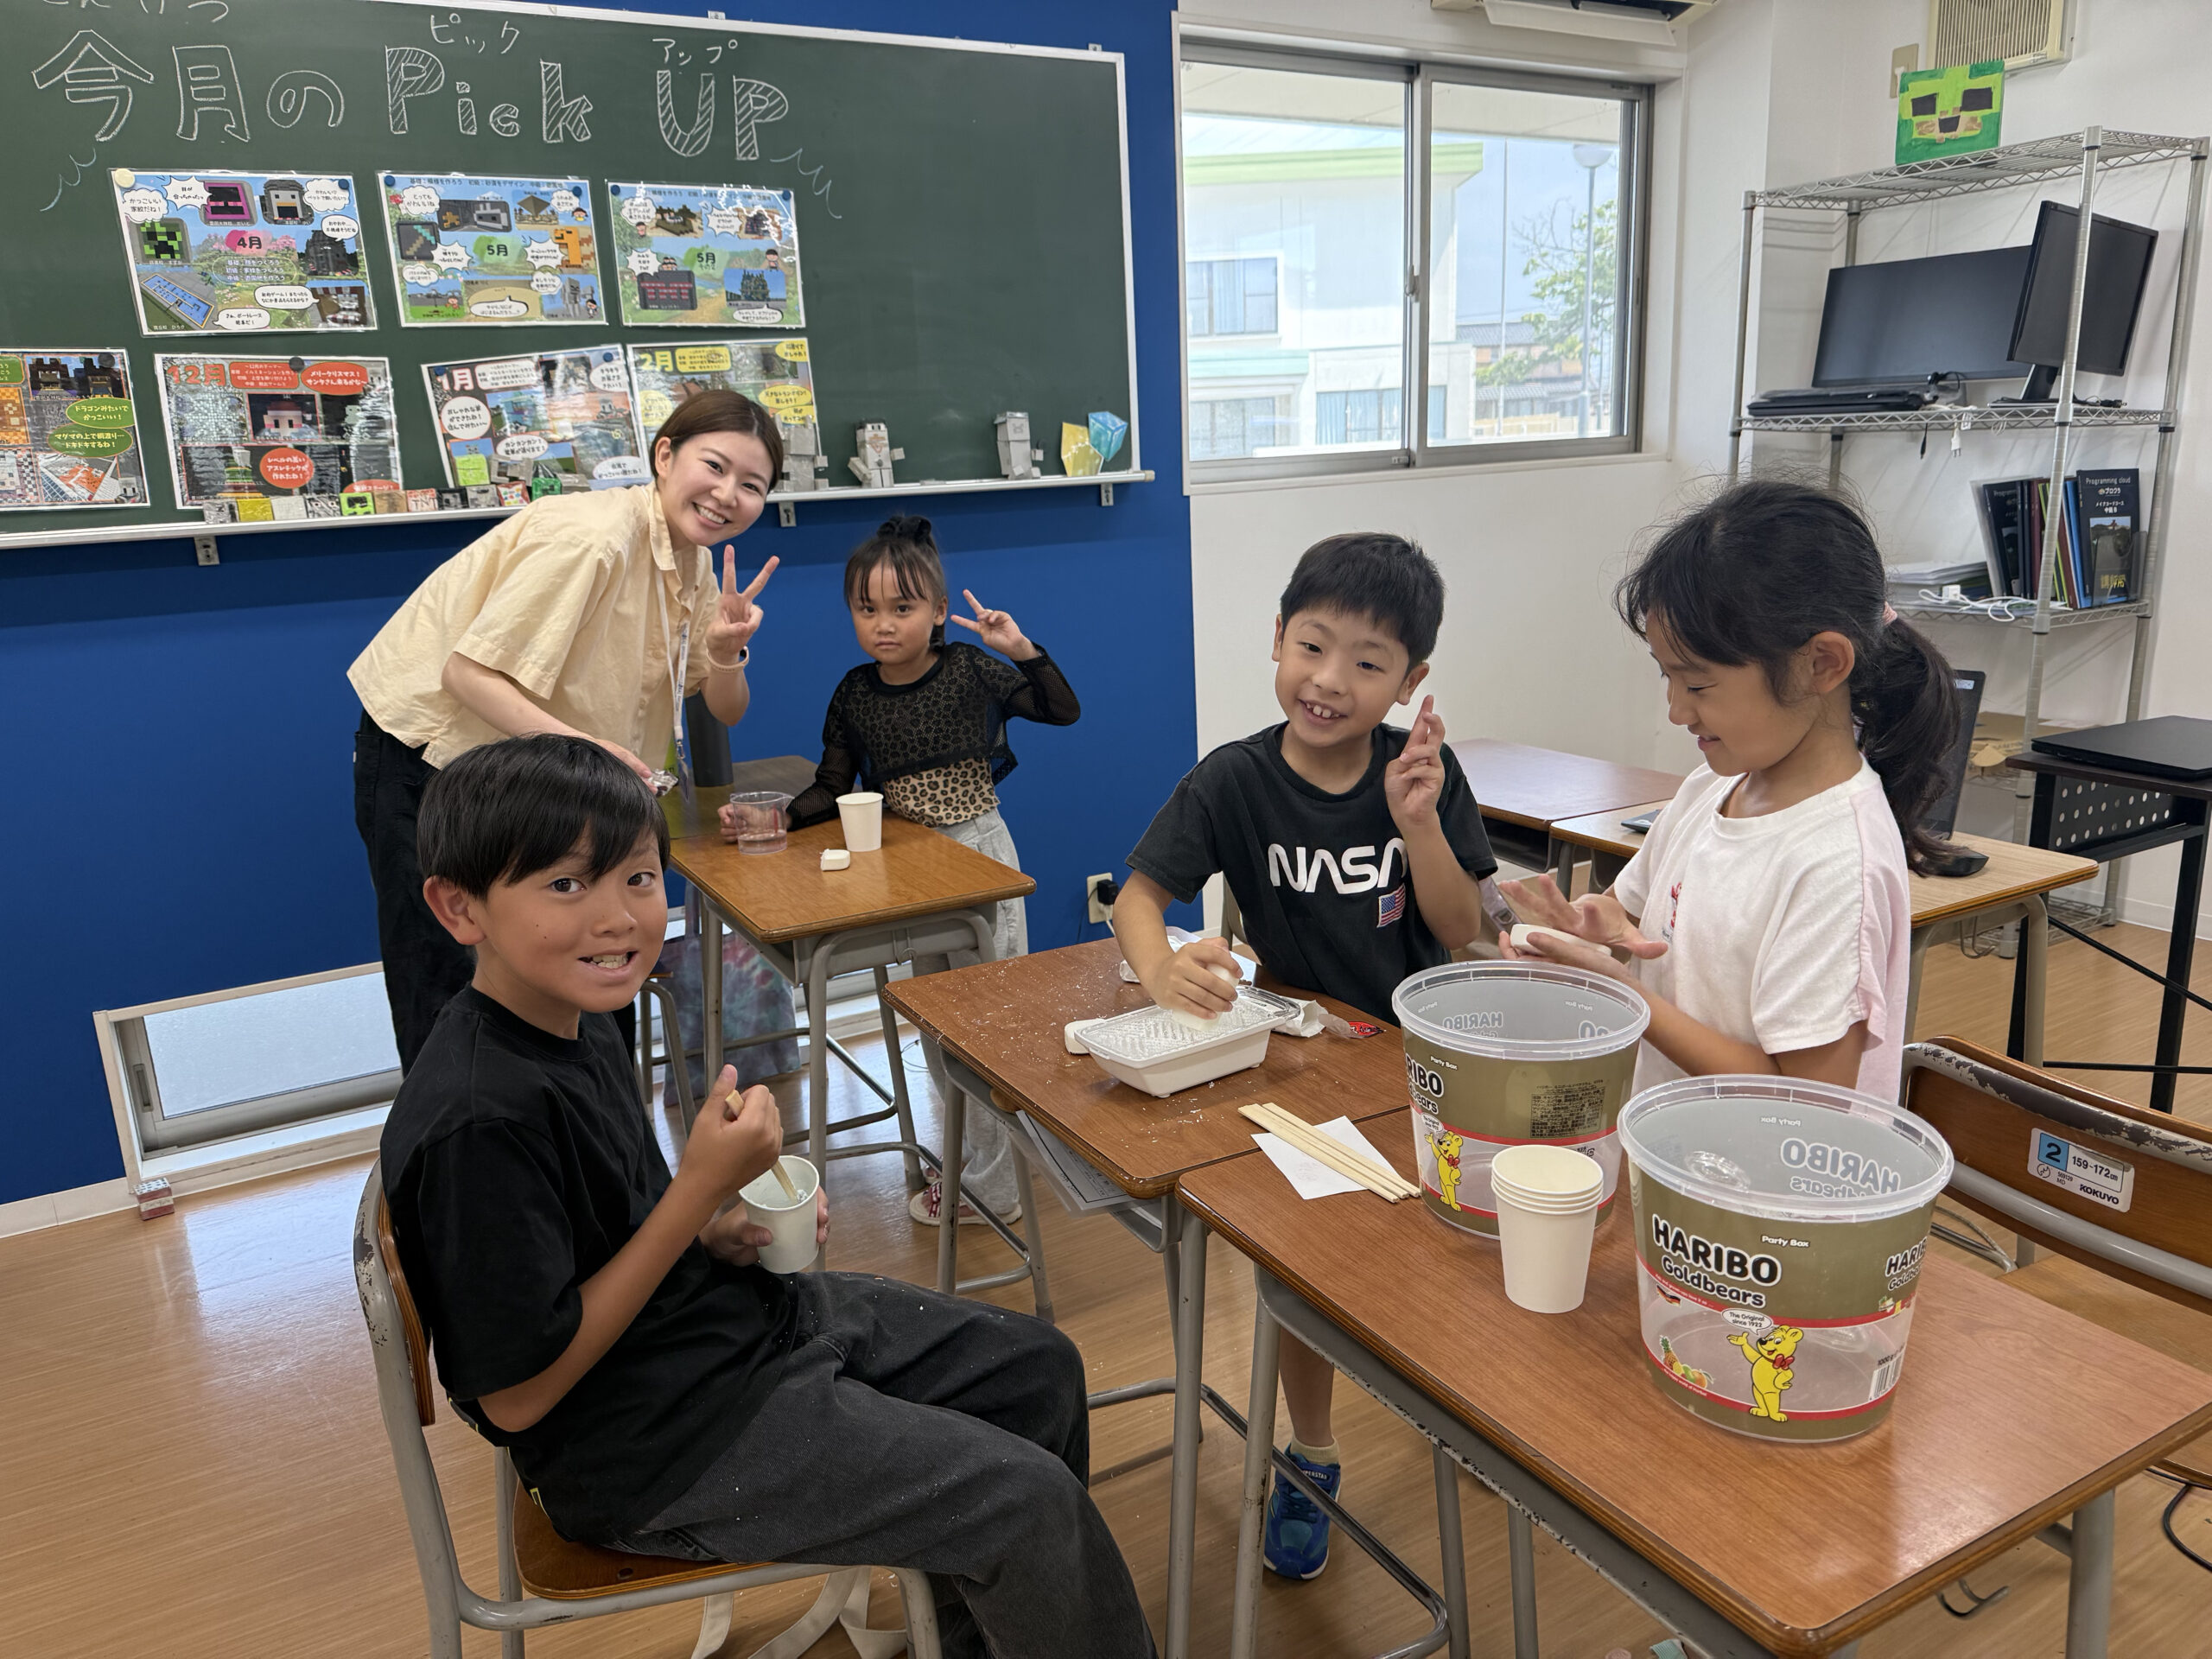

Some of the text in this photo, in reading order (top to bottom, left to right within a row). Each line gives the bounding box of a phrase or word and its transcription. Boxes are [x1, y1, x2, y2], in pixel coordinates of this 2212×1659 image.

[430, 13, 520, 54] ピック
[652, 39, 739, 65] アップ
[32, 29, 788, 161] 今月の Pick UP
[237, 236, 263, 250] 4月
[486, 244, 508, 257] 5月
[696, 252, 716, 264] 5月
[639, 350, 674, 372] 2月
[166, 363, 227, 386] 12月
[2086, 477, 2117, 486] Programming
[1268, 837, 1408, 894] NASA
[1430, 1055, 1446, 1067] Party
[1406, 1052, 1445, 1098] RIBO
[2045, 1142, 2063, 1163] 2
[2079, 1183, 2120, 1205] KOKUYO
[1652, 1215, 1783, 1287] HARIBO
[1761, 1235, 1809, 1247] Party Box
[1661, 1255, 1766, 1309] Goldbears
[1741, 1313, 1764, 1323] Original
